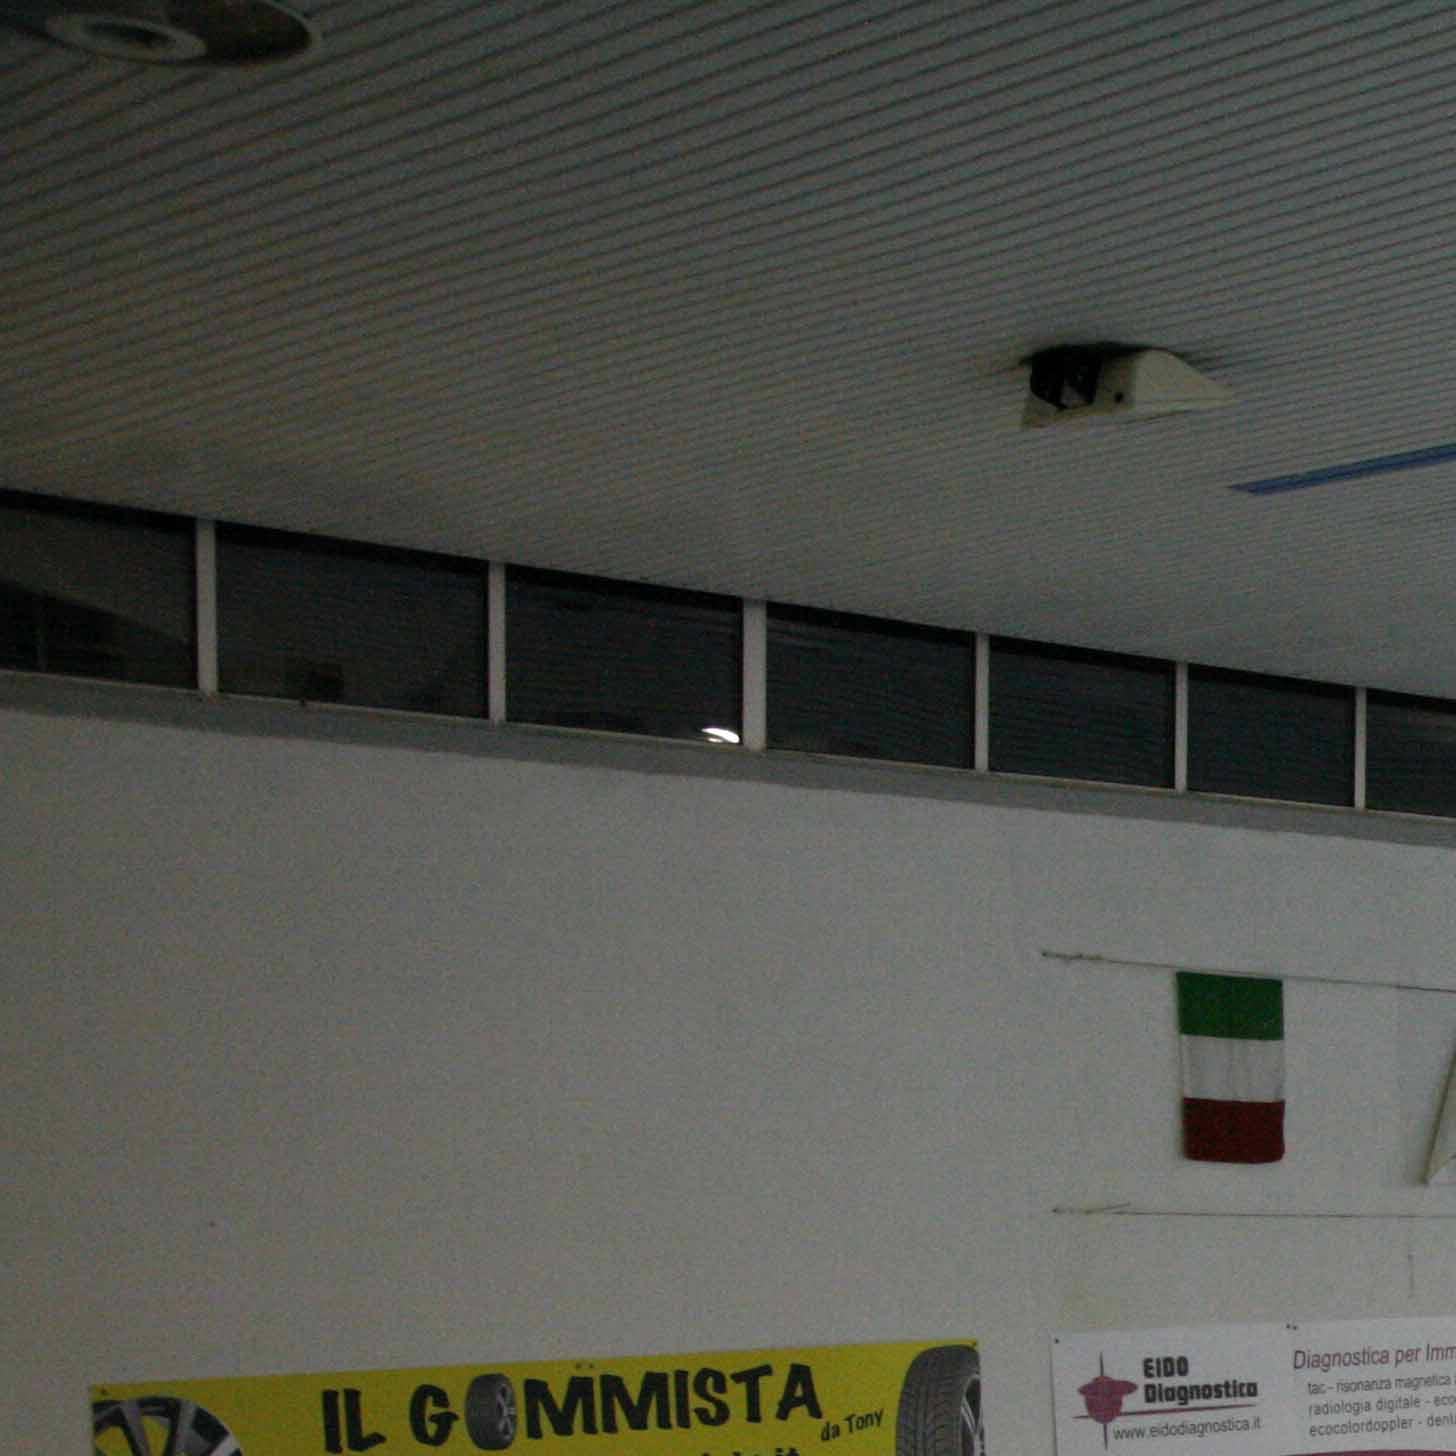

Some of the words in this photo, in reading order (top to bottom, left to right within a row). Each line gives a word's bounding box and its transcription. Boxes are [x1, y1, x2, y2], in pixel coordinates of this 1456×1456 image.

[1142, 1356, 1189, 1379] EIDO
[1293, 1346, 1390, 1373] Diagnostica
[1394, 1345, 1421, 1368] per
[1144, 1379, 1259, 1406] Diagnostica
[1308, 1381, 1326, 1395] tac
[1336, 1377, 1393, 1393] risonanza
[1394, 1372, 1451, 1391] magnetica
[1309, 1398, 1372, 1417] radiologia
[1376, 1396, 1421, 1414] digitale
[321, 1387, 387, 1454] IL
[820, 1421, 841, 1442] da
[845, 1408, 885, 1434] Tony
[1112, 1416, 1262, 1440] www.eidodiagnostica.it
[1309, 1417, 1415, 1438] ecocolordoppler
